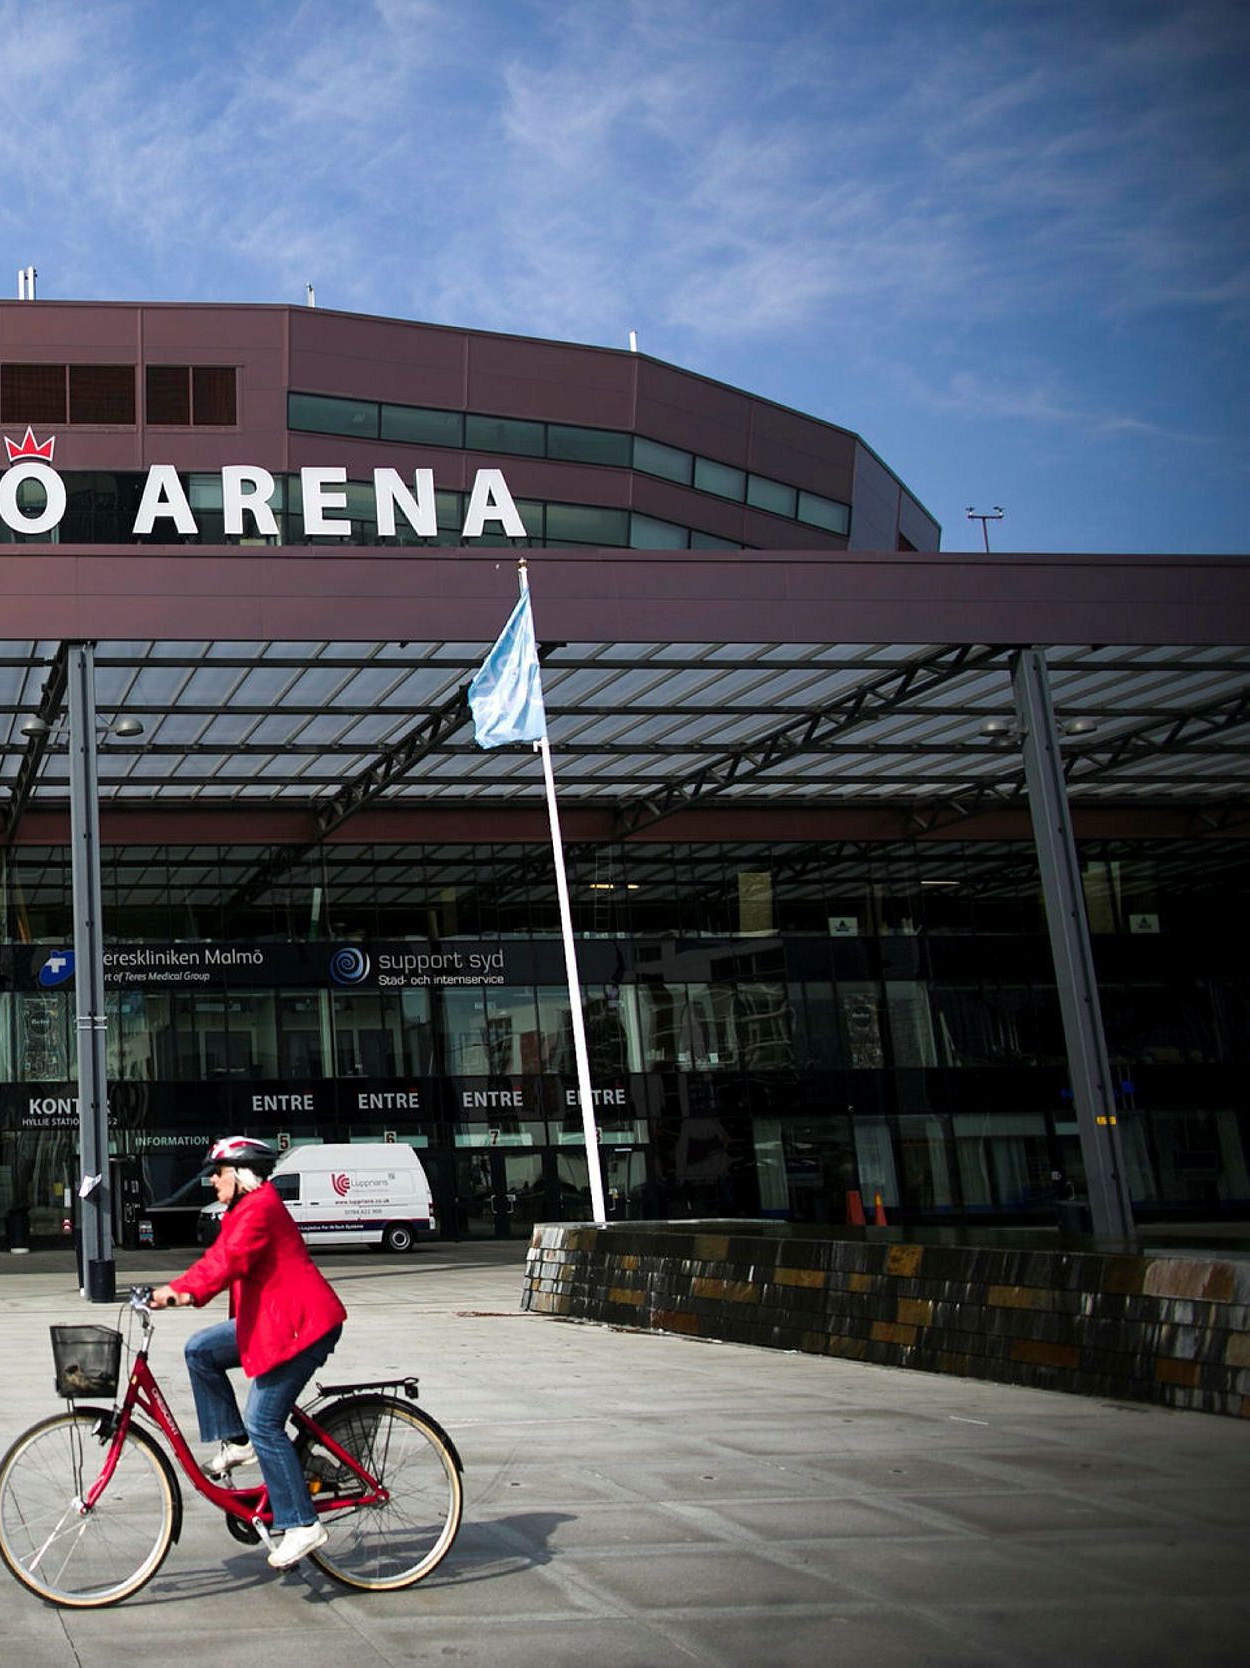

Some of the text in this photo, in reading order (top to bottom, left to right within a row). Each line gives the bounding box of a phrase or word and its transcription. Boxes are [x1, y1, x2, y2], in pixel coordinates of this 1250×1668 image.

[133, 464, 528, 538] ARENA
[103, 948, 264, 966] ereskliniken Malmö
[379, 948, 504, 974] support syd
[113, 971, 123, 982] of
[125, 972, 147, 981] Teres
[148, 971, 182, 981] Medical
[184, 971, 210, 982] Group
[411, 975, 430, 985] och
[433, 975, 504, 985] internservice
[29, 1097, 111, 1115] KONT
[22, 1117, 50, 1126] HYLLIE
[112, 1117, 118, 1125] 2
[135, 1135, 210, 1147] INFORMATION
[279, 1135, 288, 1149] 5
[491, 1130, 499, 1144] 7
